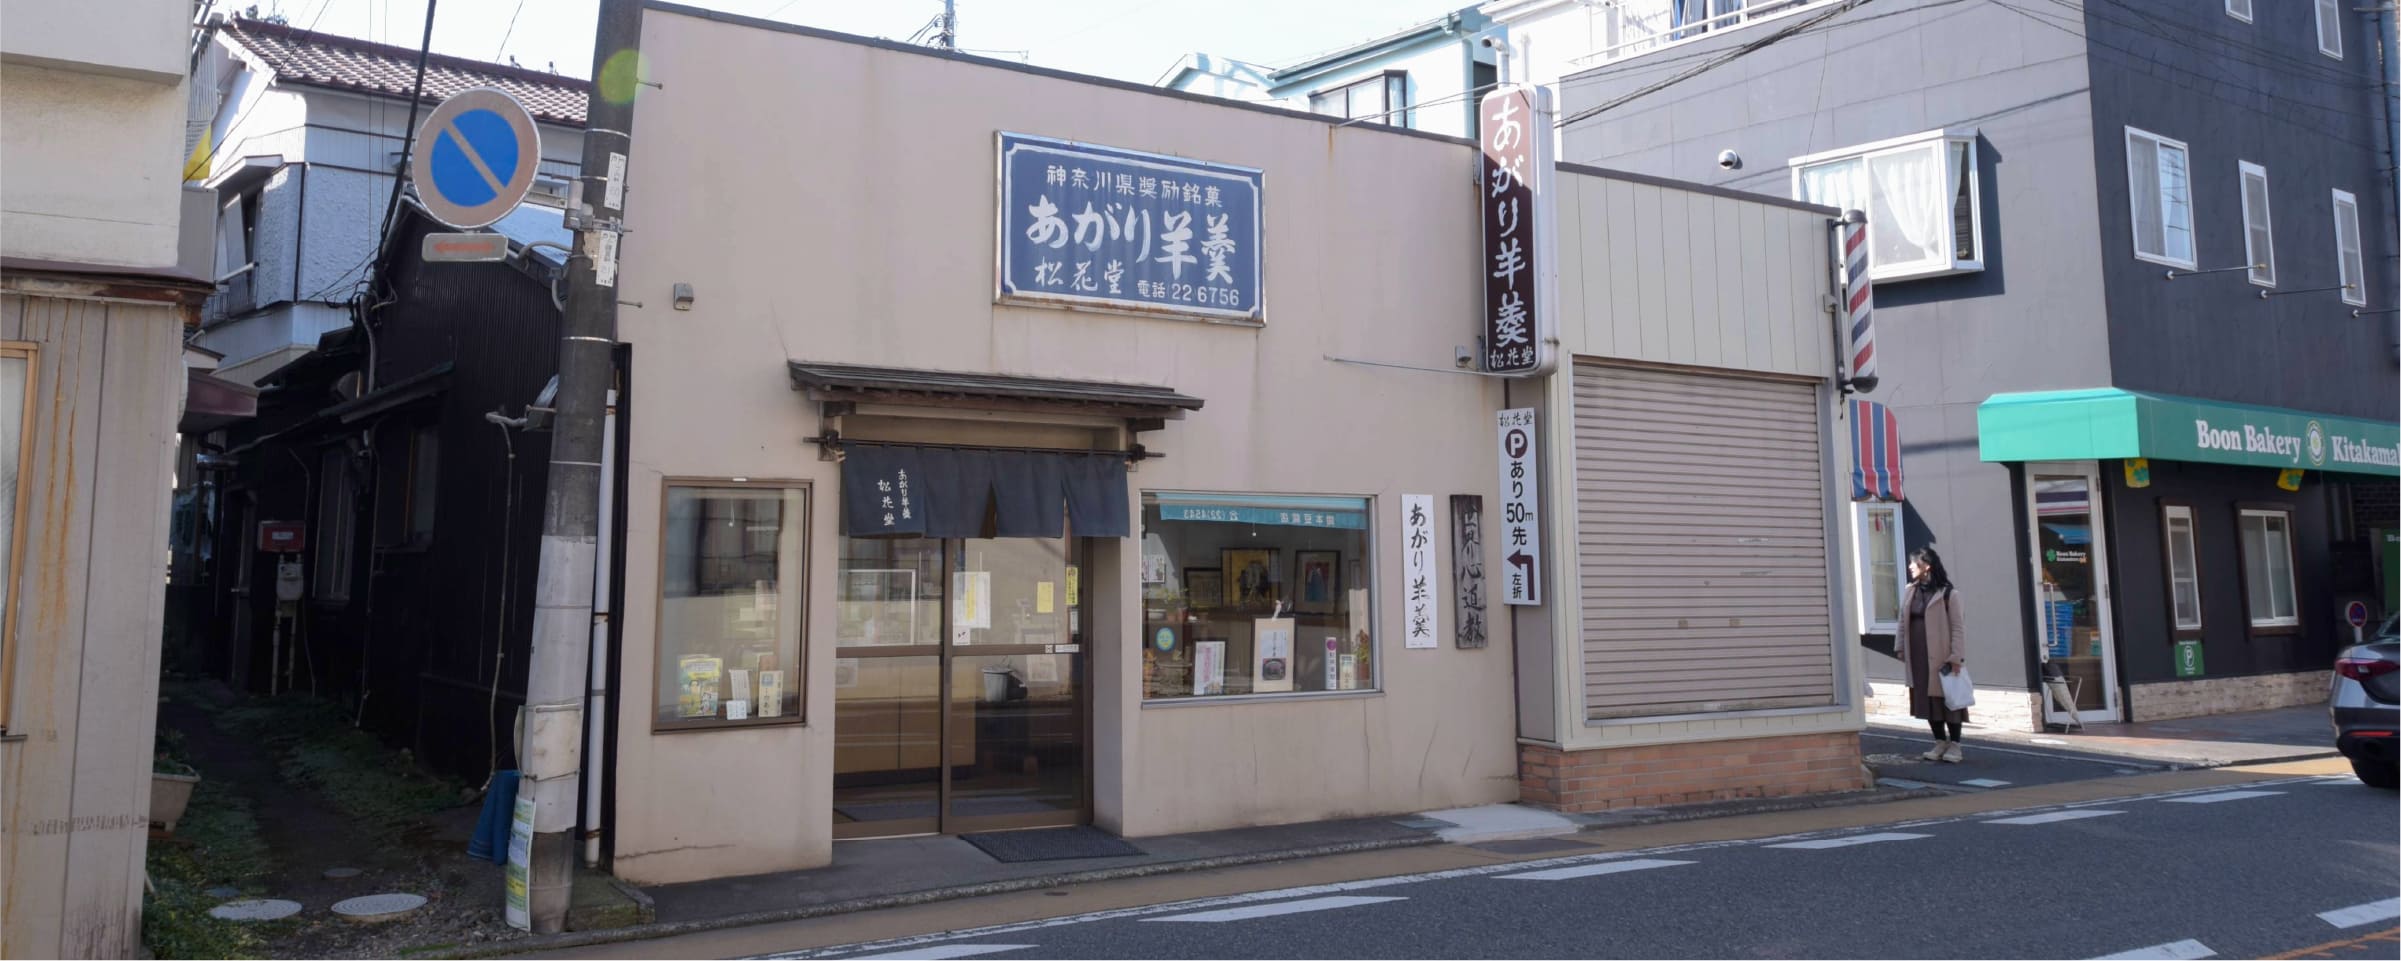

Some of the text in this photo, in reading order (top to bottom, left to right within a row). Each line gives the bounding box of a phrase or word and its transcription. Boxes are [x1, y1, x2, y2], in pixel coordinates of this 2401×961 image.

[1492, 96, 1527, 348] あがり羊羹
[1026, 194, 1236, 284] あがり羊羹
[1034, 256, 1125, 294] 松花堂
[1137, 280, 1239, 306] 電話 22 6756
[1490, 345, 1533, 368] 松花堂
[1499, 412, 1533, 427] 松花堂
[1510, 433, 1525, 456] P
[2196, 420, 2242, 451] Boon
[2244, 425, 2300, 464] Bakery
[1409, 503, 1430, 638] あがり羊羹
[1512, 573, 1523, 600] 左折
